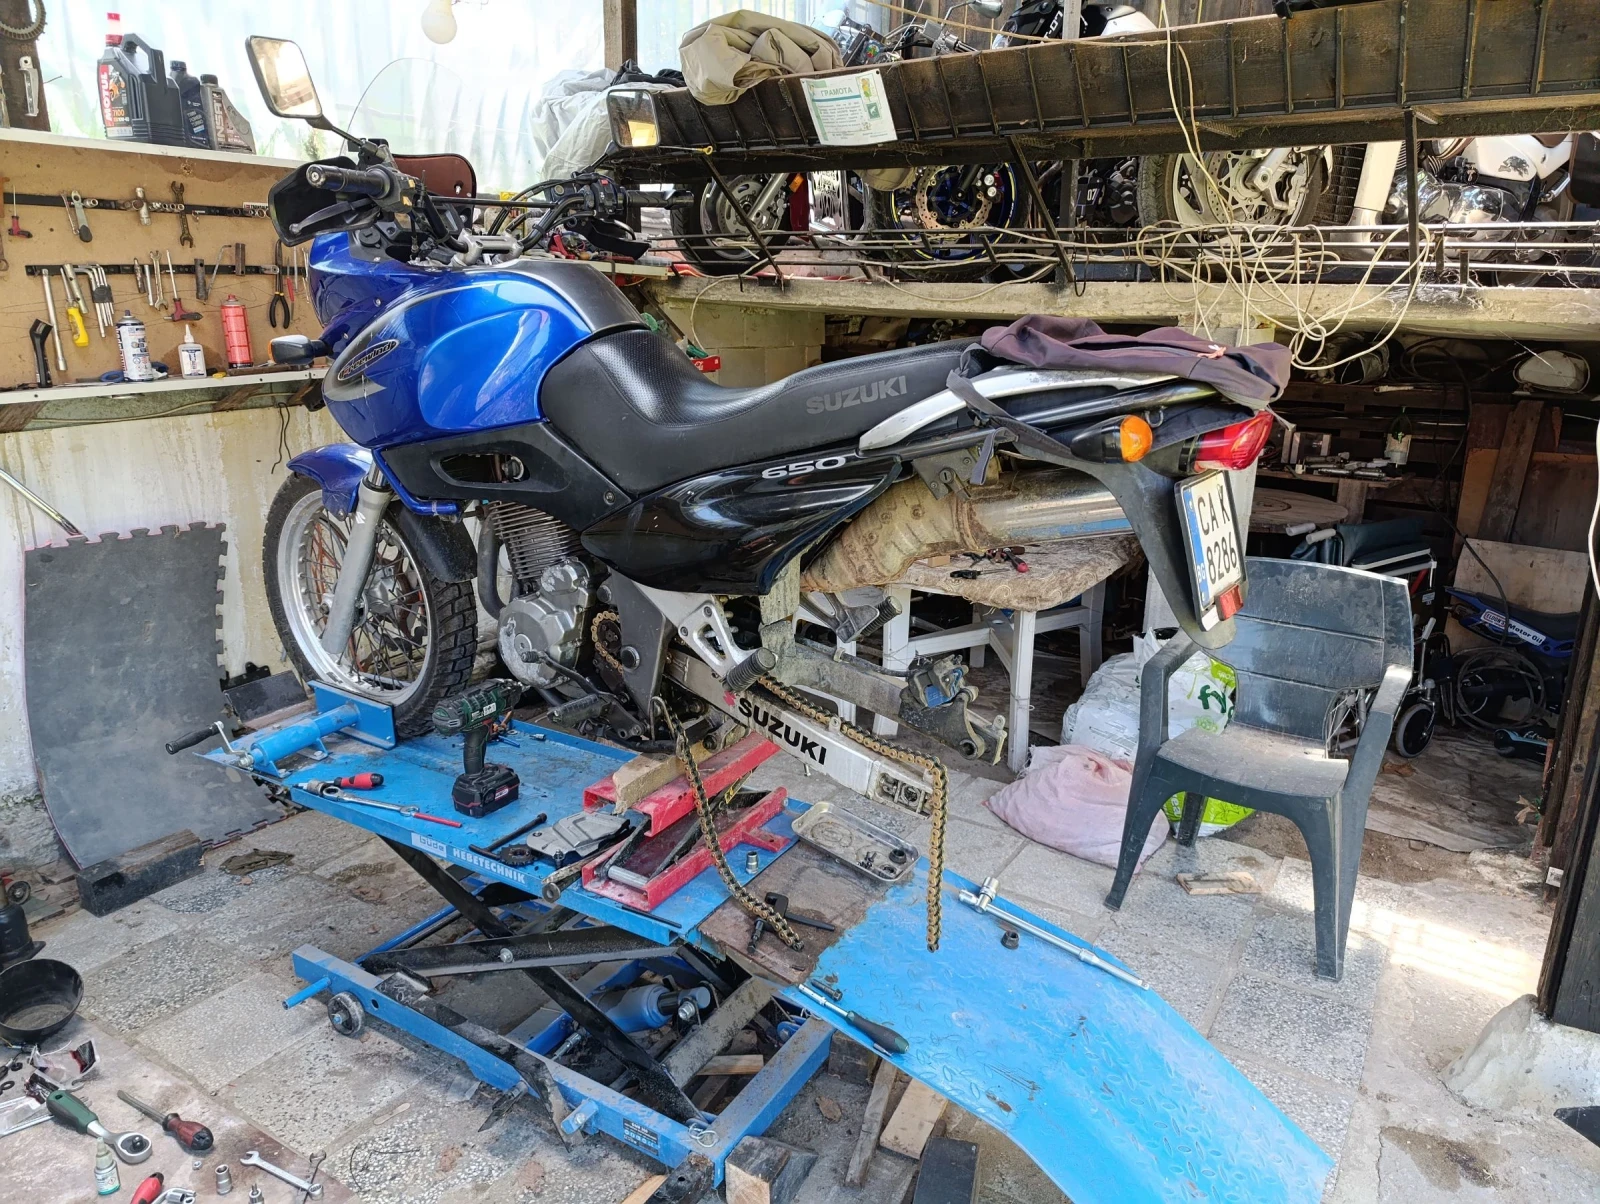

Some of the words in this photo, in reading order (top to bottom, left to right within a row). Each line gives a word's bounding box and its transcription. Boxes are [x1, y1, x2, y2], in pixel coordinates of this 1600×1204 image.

[100, 71, 113, 122] MOTUL
[820, 87, 853, 97] ГРАМОТА
[1086, 188, 1098, 201] 07
[339, 341, 398, 380] Freewind
[805, 375, 908, 415] SUZUKI
[761, 456, 846, 479] 650
[1197, 491, 1219, 536] CA
[1217, 485, 1231, 525] K
[1196, 562, 1207, 584] BG
[1206, 531, 1238, 585] 8286
[1508, 622, 1532, 638] Motor
[1531, 634, 1543, 644] Oil
[738, 697, 827, 766] SUZUKI
[452, 847, 526, 885] HEBETECHNIK
